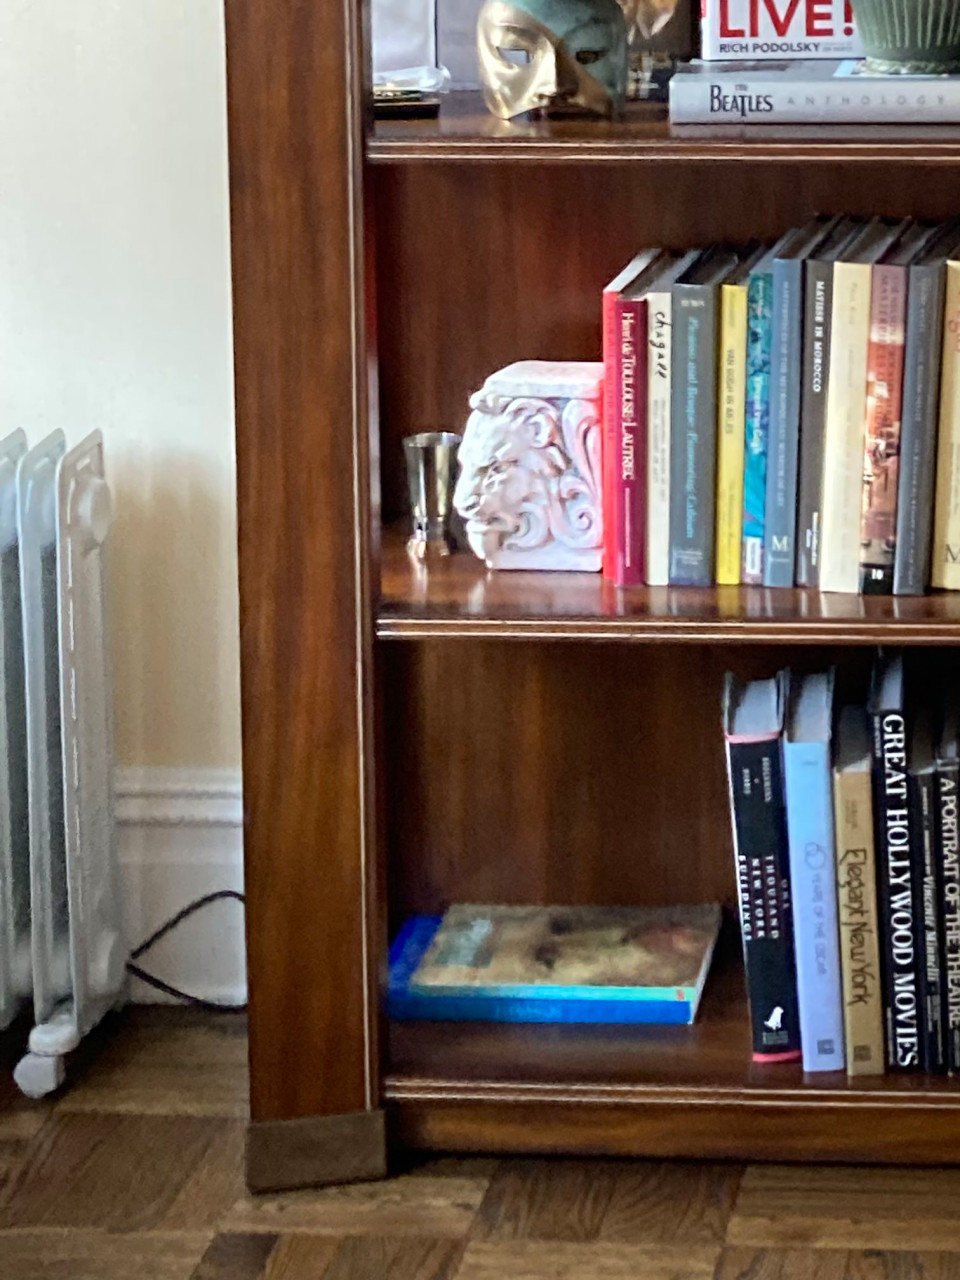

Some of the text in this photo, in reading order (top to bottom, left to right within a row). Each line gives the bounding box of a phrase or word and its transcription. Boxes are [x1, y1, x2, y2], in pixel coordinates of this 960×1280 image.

[719, 43, 749, 53] RICH
[752, 42, 820, 53] PODOLSKY
[710, 85, 773, 117] BEATLES
[786, 95, 945, 106] ANTHOLOGY
[621, 312, 635, 341] Henri
[812, 281, 824, 392] MATISSE IN MOROCCO
[940, 778, 955, 791] A
[941, 796, 960, 879] PORTRAIT
[751, 857, 766, 939] NEW YORK
[765, 854, 780, 940] THOUSAND
[882, 713, 919, 1067] GREAT HOLLYWOOD MOVIES
[945, 883, 960, 906] OF
[813, 906, 824, 919] OF
[838, 848, 874, 1006] Elegant New York
[946, 911, 960, 946] THE
